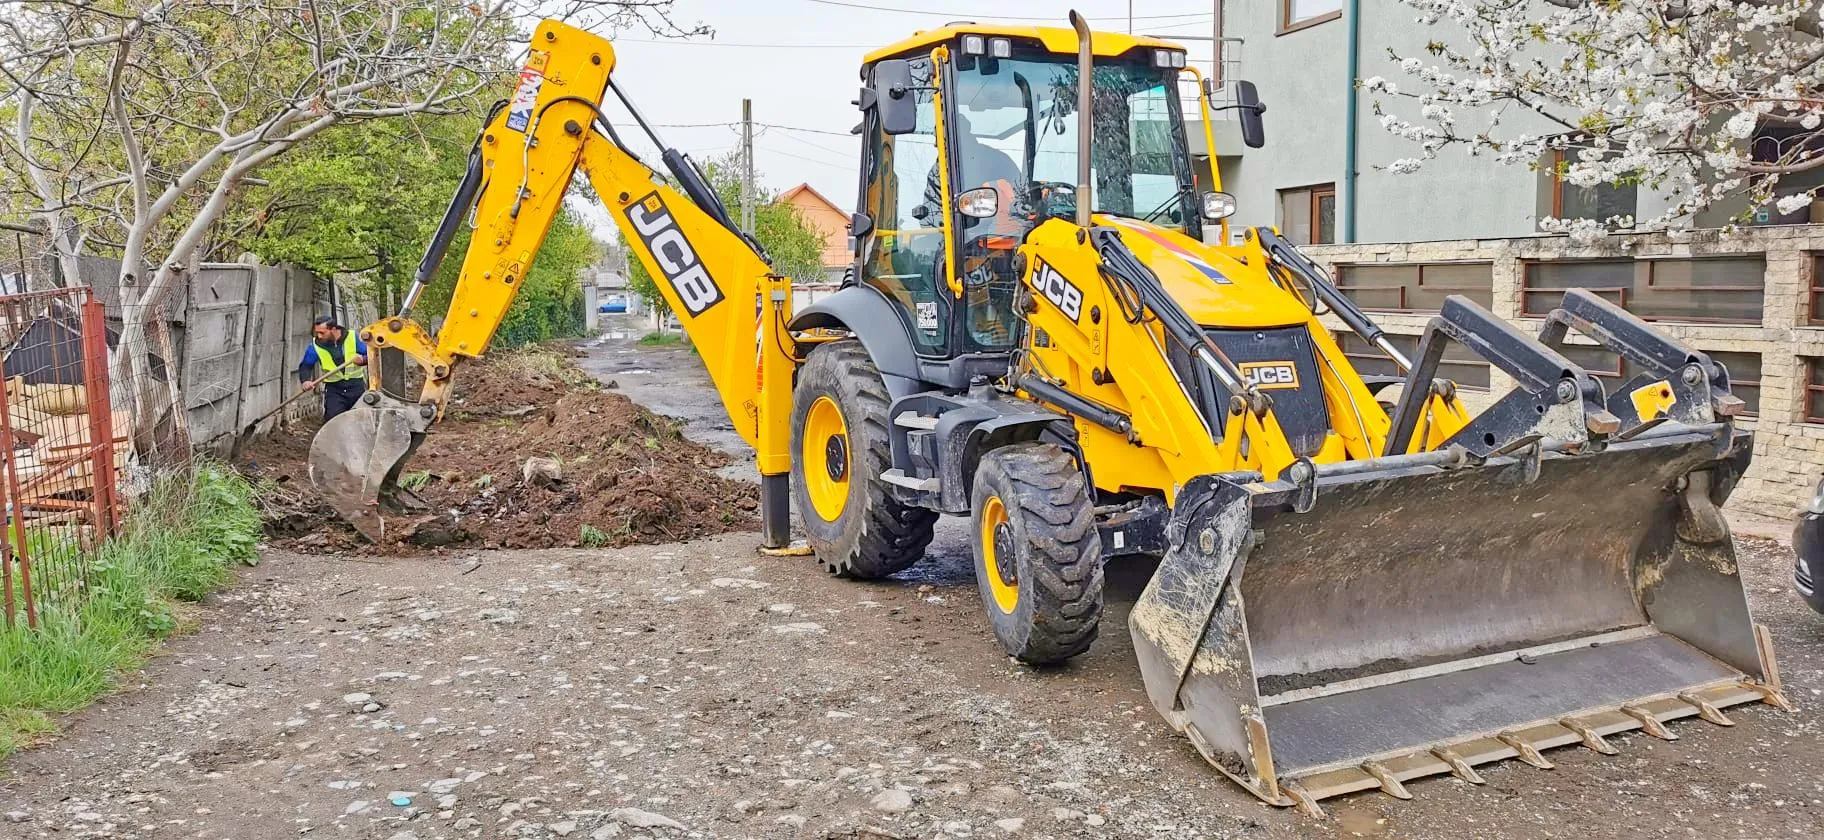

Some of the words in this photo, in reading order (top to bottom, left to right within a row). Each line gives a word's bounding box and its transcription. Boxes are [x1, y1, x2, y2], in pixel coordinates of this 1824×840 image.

[630, 204, 718, 312] JCB
[1032, 263, 1082, 321] JCB
[1245, 367, 1294, 385] JCB
